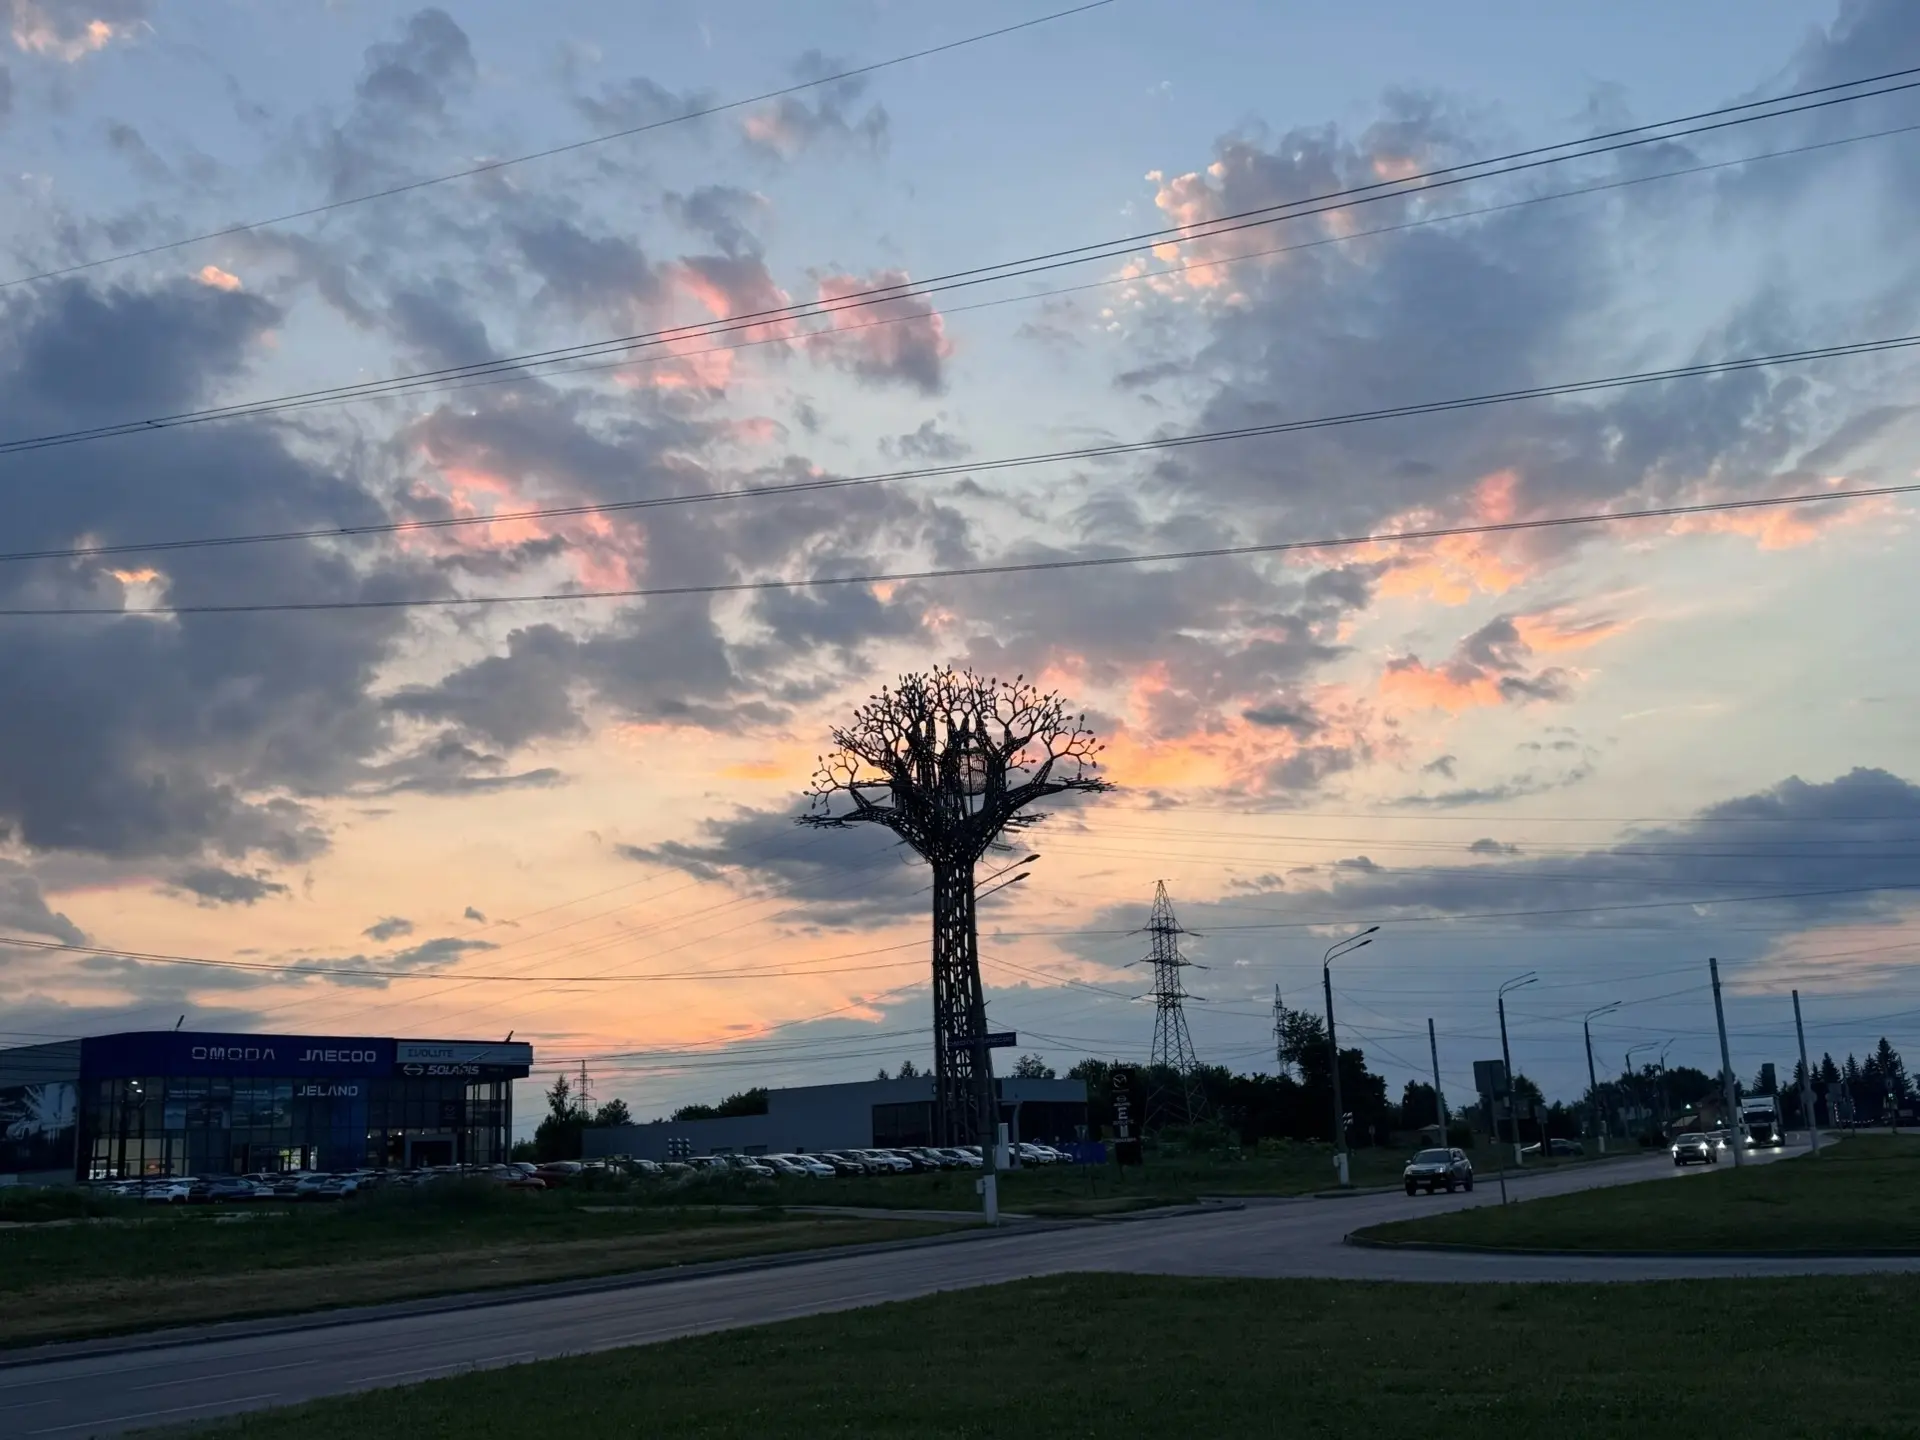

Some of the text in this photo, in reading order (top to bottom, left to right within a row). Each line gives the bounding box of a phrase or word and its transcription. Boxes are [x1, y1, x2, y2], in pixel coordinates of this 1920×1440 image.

[191, 1046, 276, 1061] OMODA
[299, 1049, 377, 1063] JAECOO
[297, 1084, 359, 1097] JELAND
